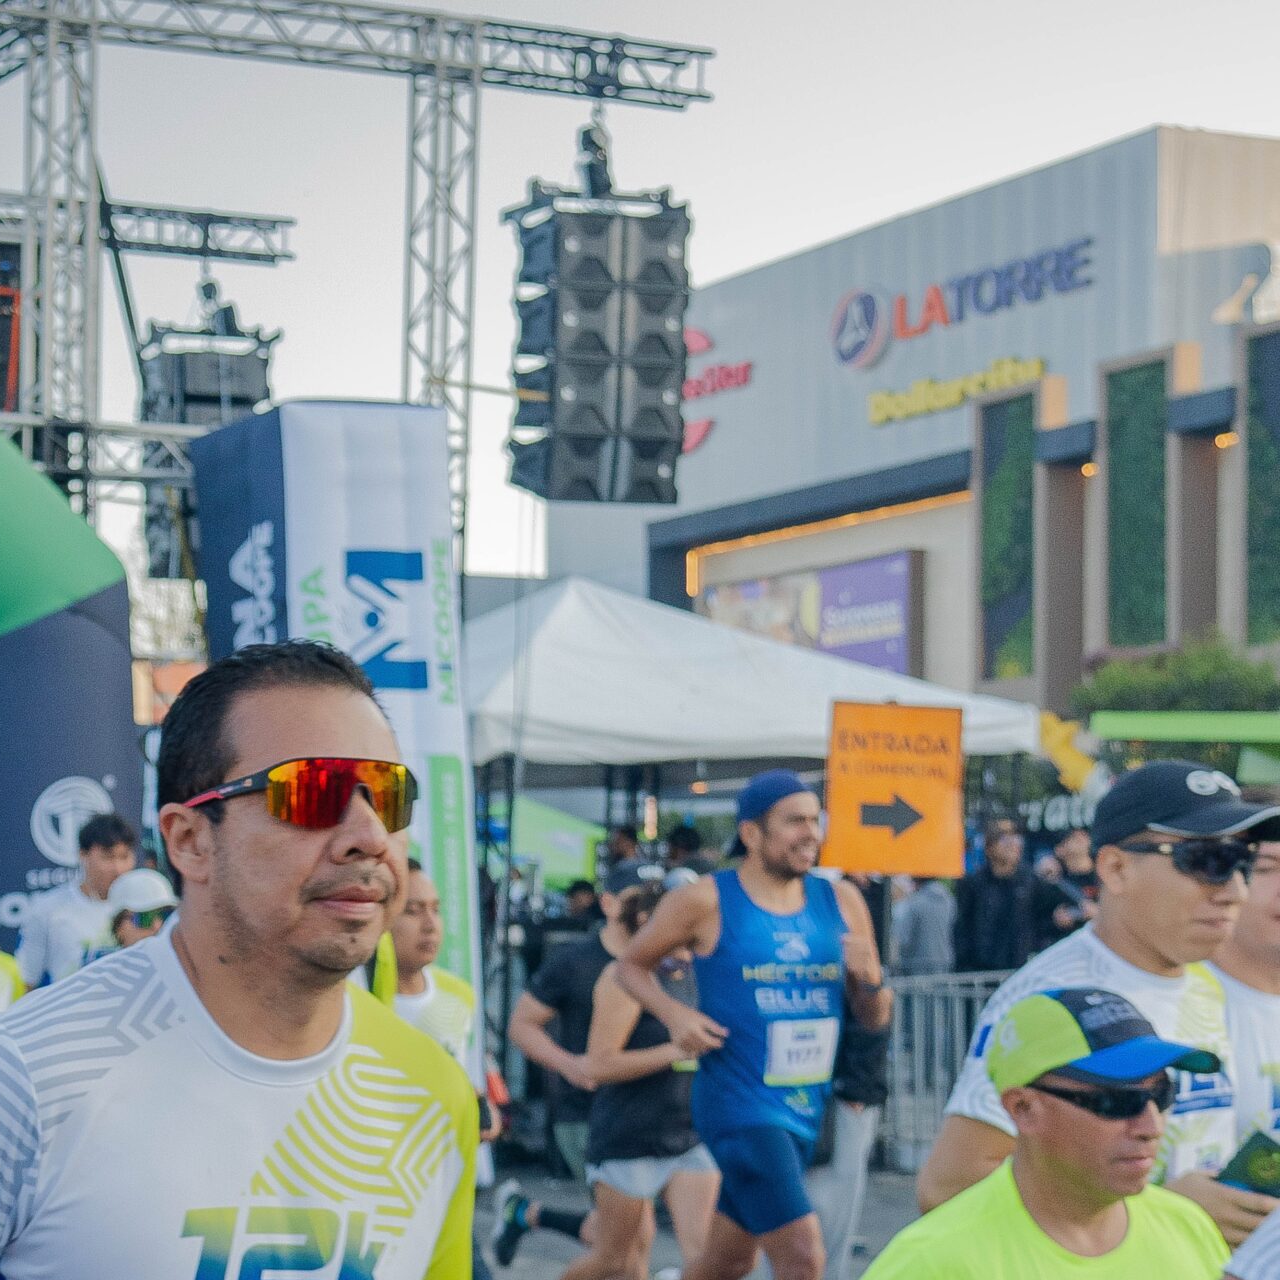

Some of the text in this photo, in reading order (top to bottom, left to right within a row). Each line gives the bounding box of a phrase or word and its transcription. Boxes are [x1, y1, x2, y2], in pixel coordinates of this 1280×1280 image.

[892, 236, 1095, 341] LATORRE
[430, 535, 457, 704] MICOOPE
[837, 728, 952, 756] ENTRADA
[753, 986, 830, 1014] BLUE
